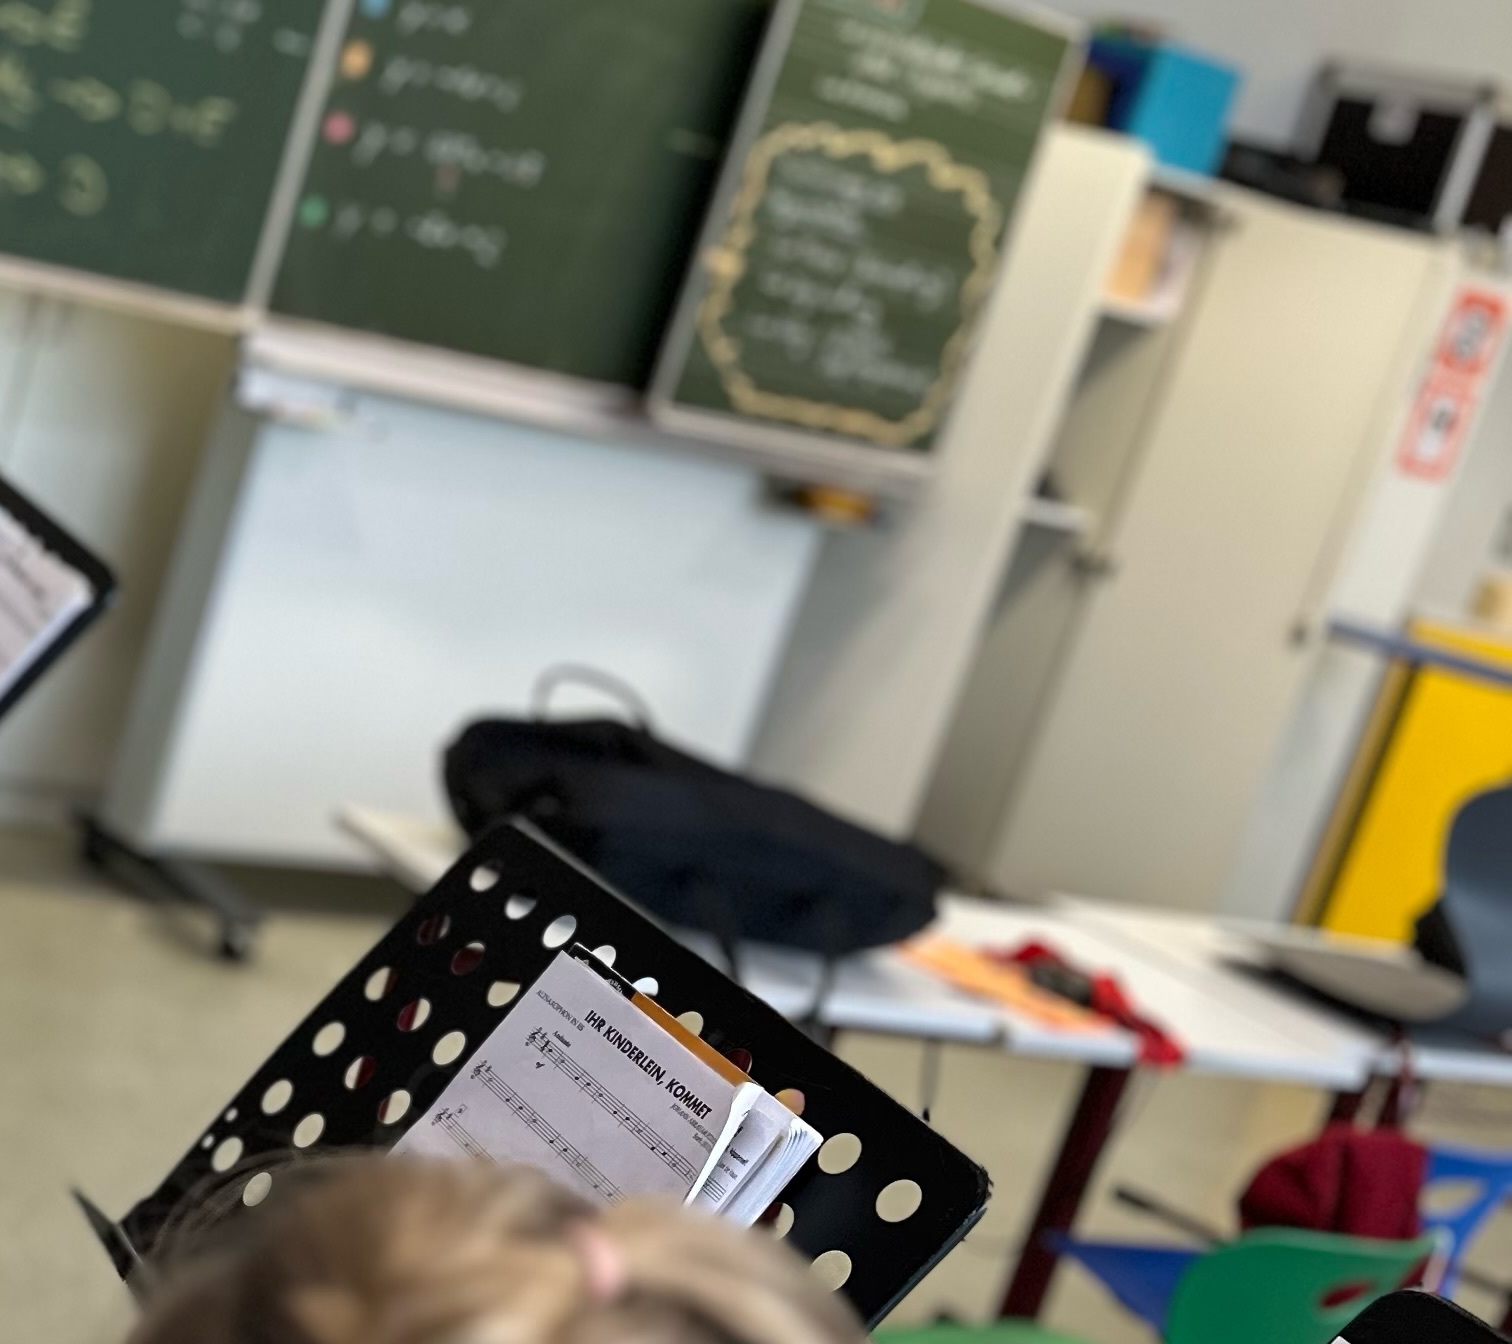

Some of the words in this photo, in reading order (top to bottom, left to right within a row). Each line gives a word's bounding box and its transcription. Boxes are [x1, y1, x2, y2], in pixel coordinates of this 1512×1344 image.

[584, 1009, 607, 1033] IHR
[602, 1025, 667, 1086] KINDERLEIN,
[665, 1077, 713, 1120] KOMMET
